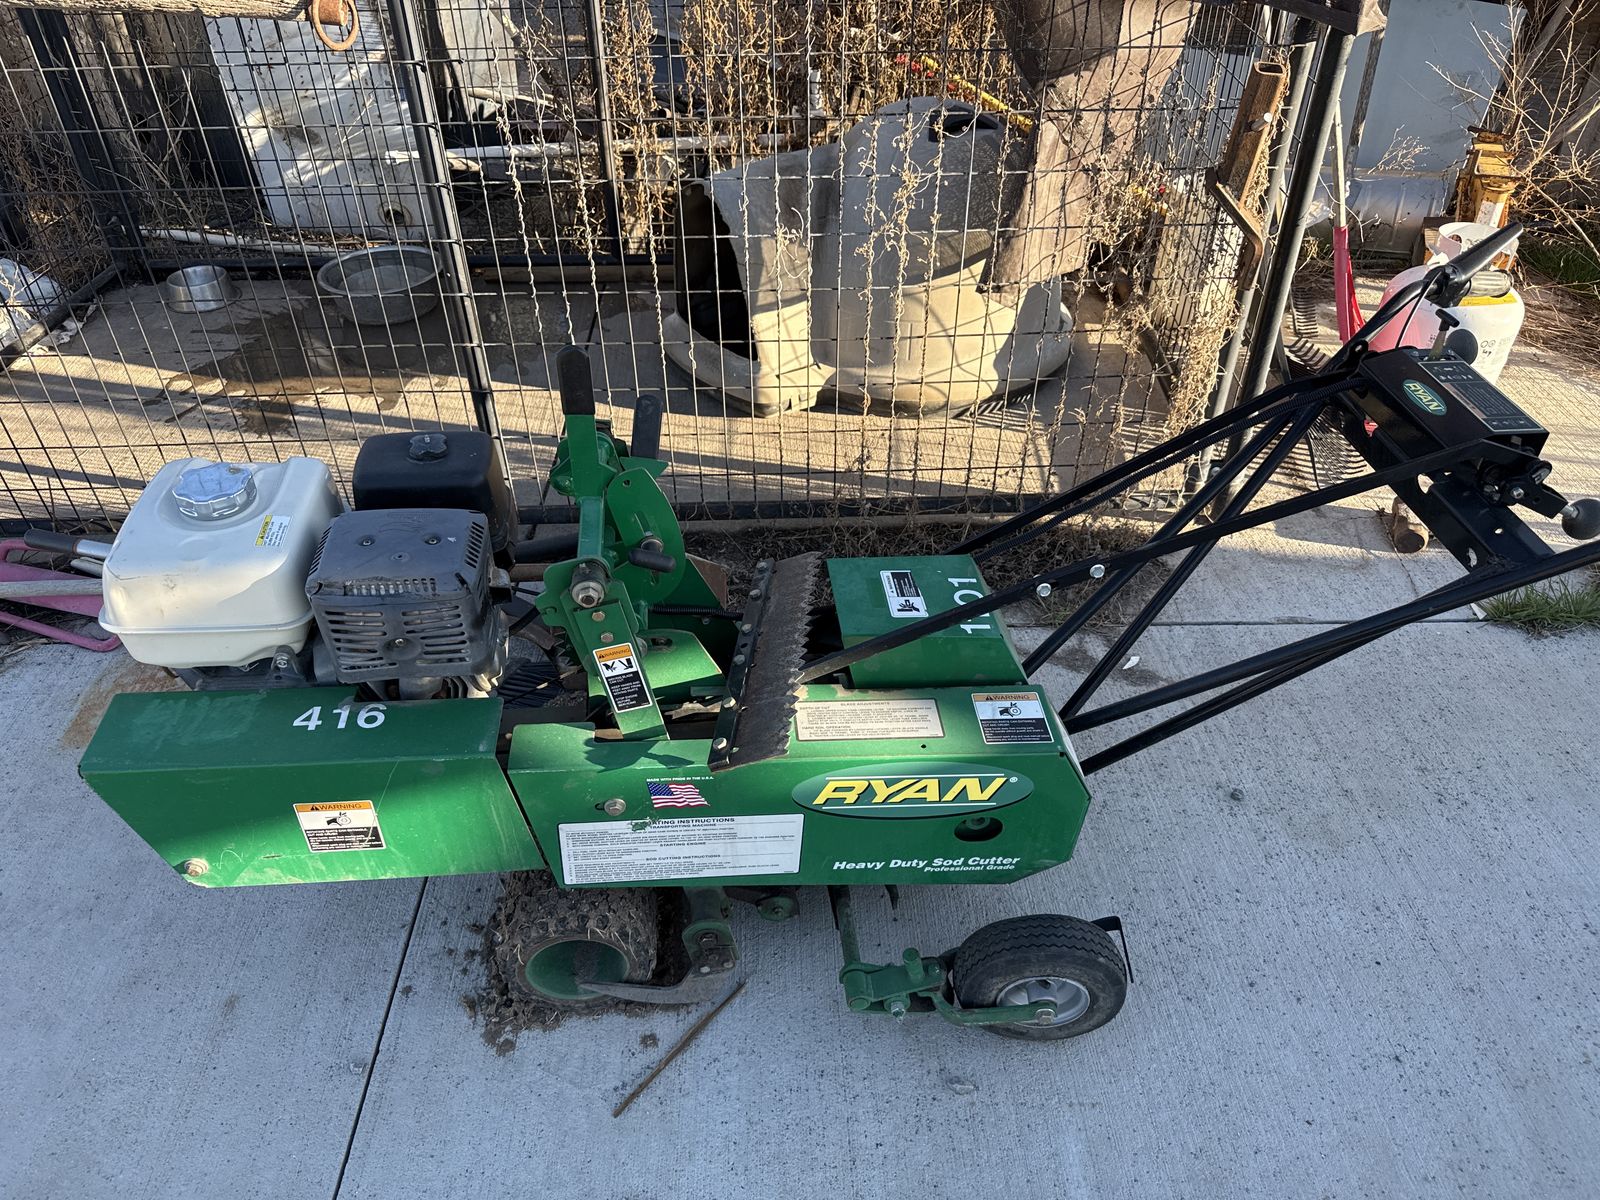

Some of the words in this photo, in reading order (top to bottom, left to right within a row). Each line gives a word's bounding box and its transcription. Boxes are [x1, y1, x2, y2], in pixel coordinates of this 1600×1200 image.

[1404, 382, 1443, 412] RYAN
[947, 577, 992, 634] 101
[292, 703, 388, 731] 416
[812, 777, 1008, 805] RYAN
[320, 802, 362, 811] WARNING
[677, 817, 735, 825] INSTRUCTIONS
[832, 860, 886, 870] Heavy
[889, 859, 928, 869] Duty
[931, 857, 965, 866] Sod
[967, 856, 1021, 866] Cutter
[923, 864, 984, 873] Professional
[986, 863, 1015, 871] Grade
